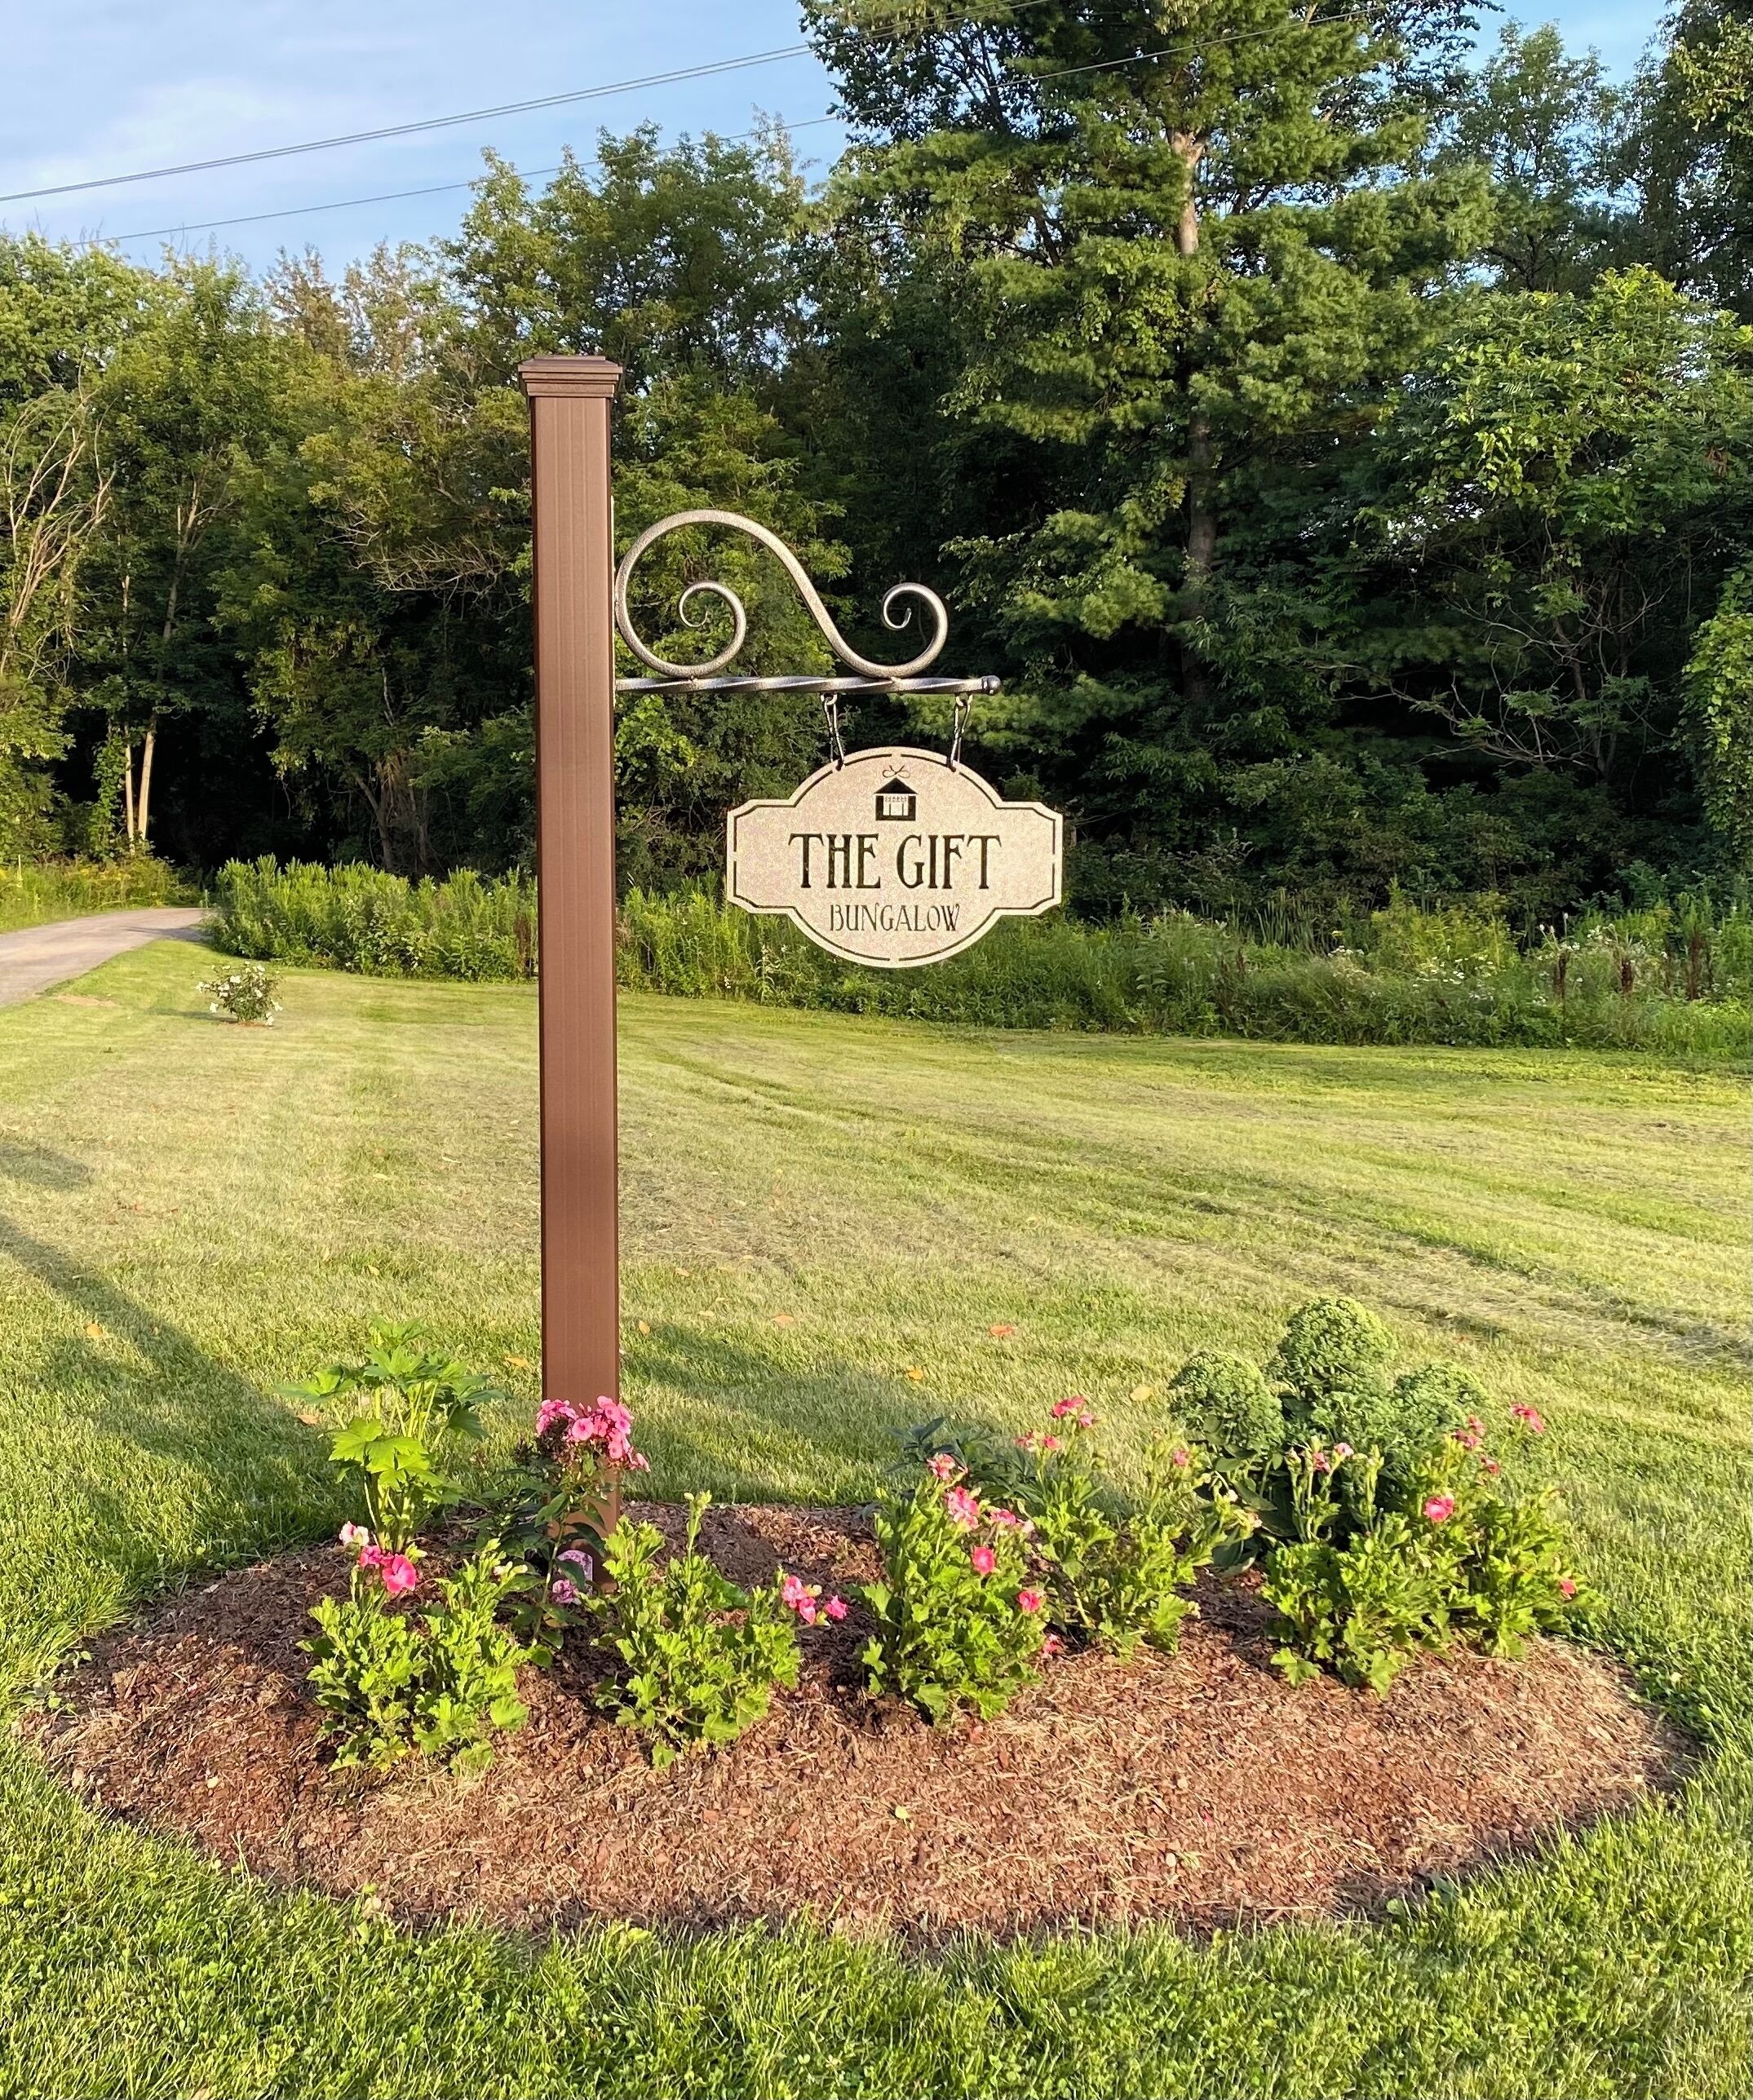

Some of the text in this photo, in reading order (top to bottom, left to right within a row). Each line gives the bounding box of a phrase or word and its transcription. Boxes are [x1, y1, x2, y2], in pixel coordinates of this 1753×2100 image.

[788, 833, 1002, 890] THE GIFT
[829, 903, 960, 931] BUNGALOW
